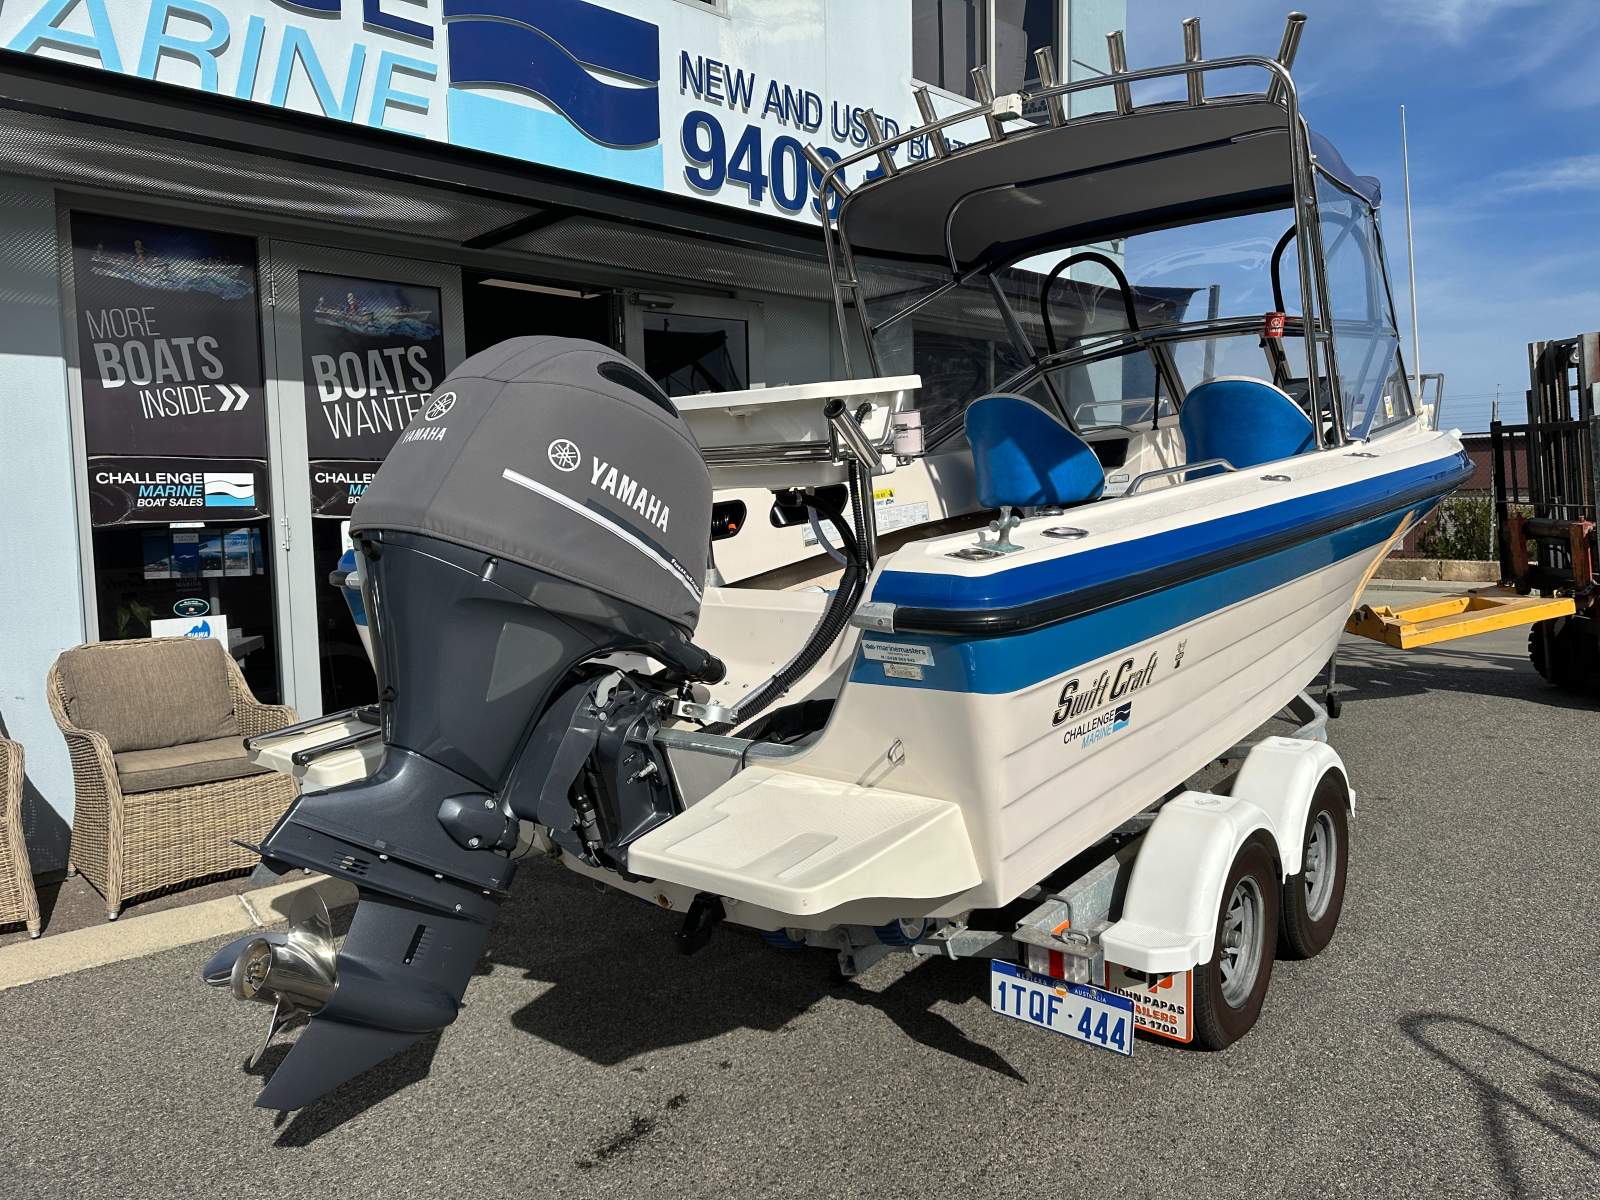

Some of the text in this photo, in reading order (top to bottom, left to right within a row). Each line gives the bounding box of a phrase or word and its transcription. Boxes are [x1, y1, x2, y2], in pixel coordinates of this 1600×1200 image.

[681, 49, 756, 109] NEW
[763, 79, 823, 129] AND
[833, 100, 900, 153] USD
[85, 306, 161, 340] MORE
[93, 335, 224, 389] BOATS
[311, 345, 433, 403] BOATS
[139, 384, 216, 419] INSIDE
[322, 393, 432, 440] WANTE
[402, 427, 448, 445] YAMAHA
[95, 472, 203, 484] CHALLENGE
[138, 485, 203, 497] MARINE
[590, 455, 671, 533] YAMAHA
[137, 498, 204, 507] BOAT SALES
[1051, 650, 1158, 728] Swift Craft
[1063, 708, 1115, 745] CHALLENGE
[1081, 723, 1113, 750] MARINE
[1113, 986, 1185, 1015] JOHN PAPAS
[1136, 1004, 1178, 1025] AILERS
[1149, 1020, 1178, 1035] 1700
